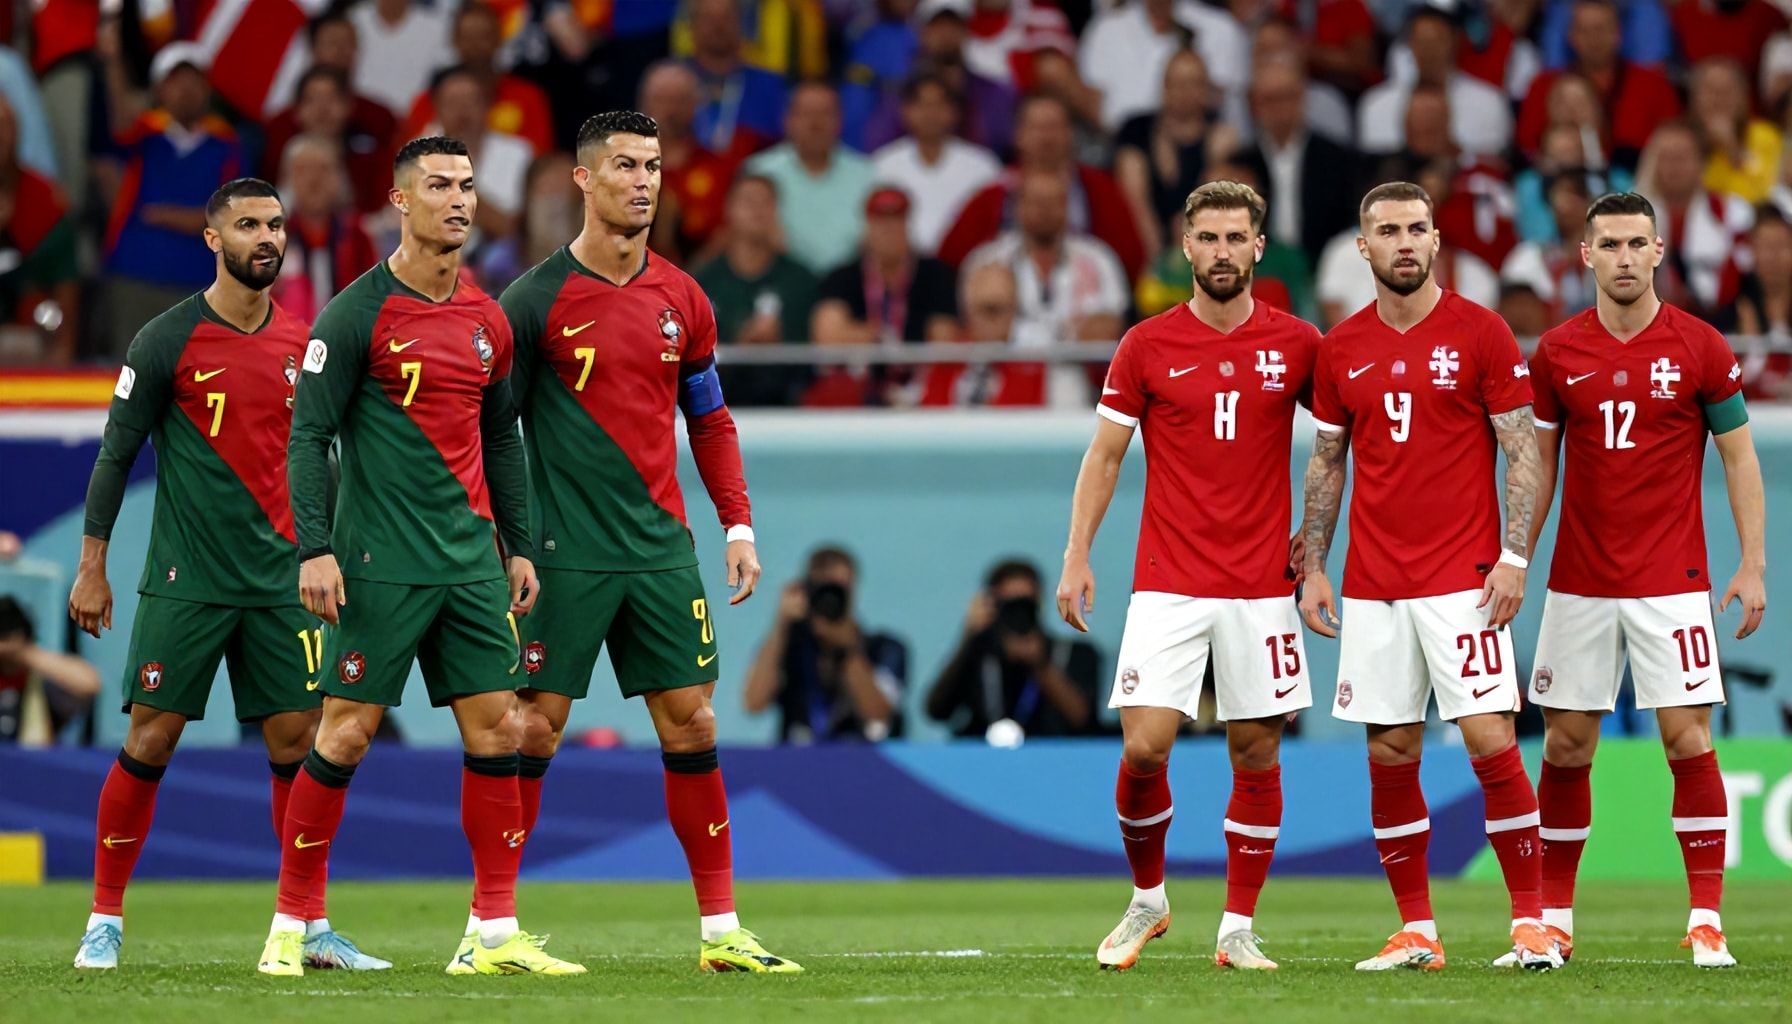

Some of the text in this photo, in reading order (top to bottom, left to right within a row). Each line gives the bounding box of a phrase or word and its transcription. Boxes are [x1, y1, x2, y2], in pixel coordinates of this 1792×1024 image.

[401, 362, 422, 407] 7
[574, 347, 596, 392] 7
[207, 393, 226, 438] 7
[1598, 400, 1637, 449] 12
[1265, 633, 1301, 680] 15
[1456, 630, 1502, 678] 20
[1672, 625, 1711, 672] 10
